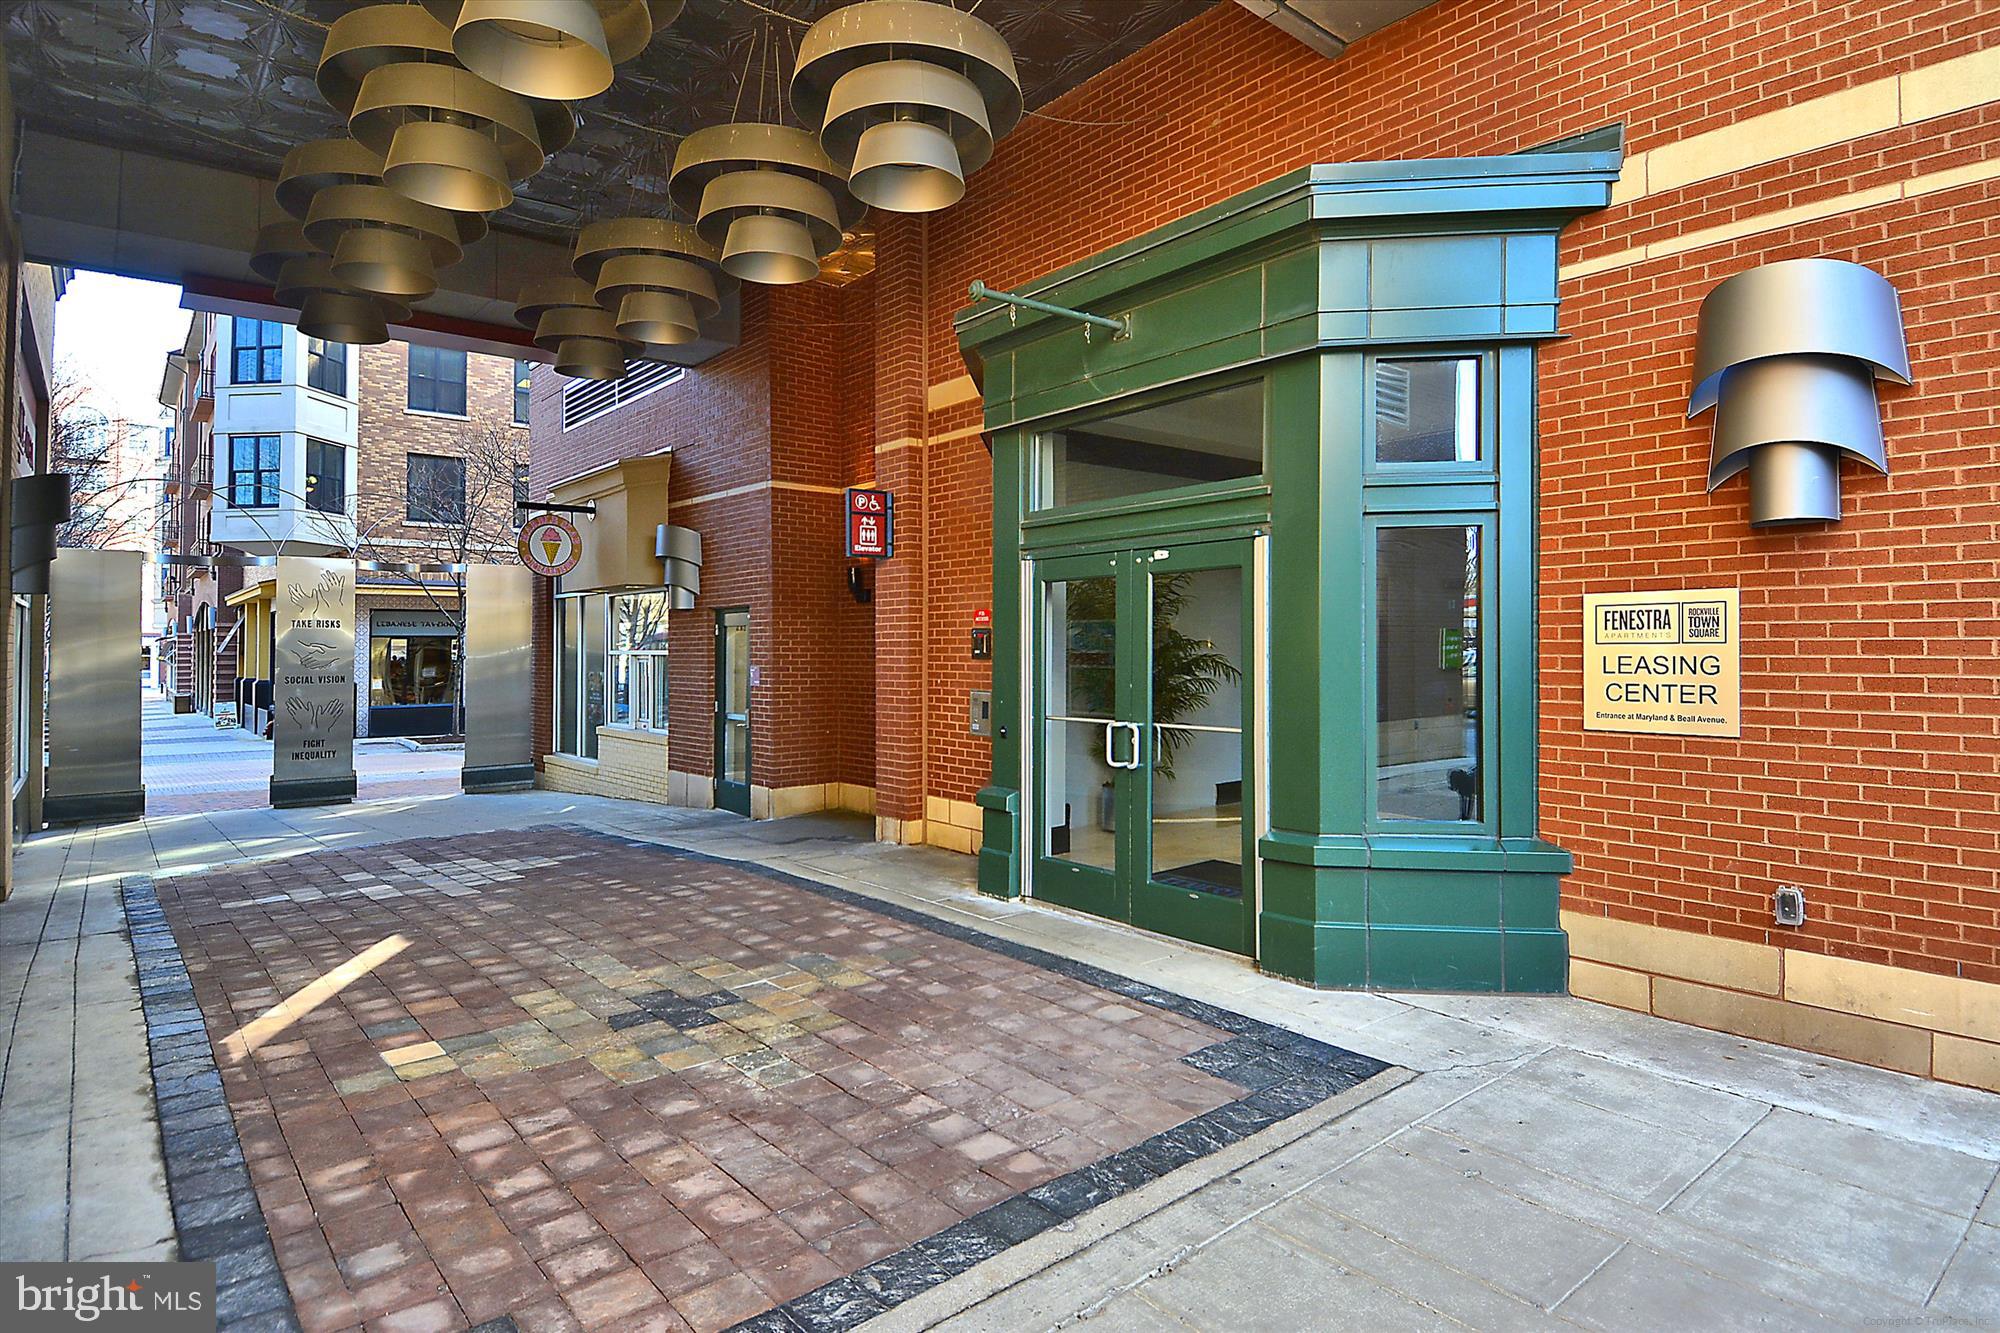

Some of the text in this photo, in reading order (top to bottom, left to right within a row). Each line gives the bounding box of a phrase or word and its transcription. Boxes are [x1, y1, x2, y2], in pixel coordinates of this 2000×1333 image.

[854, 545, 882, 553] Elevator
[1688, 607, 1720, 616] ROCKVILLE
[291, 620, 341, 628] TAKE RISKS
[1604, 609, 1671, 631] FENESTRA
[1688, 616, 1720, 628] TOWN
[1604, 631, 1672, 639] APARTMENTS
[1688, 628, 1720, 638] SQUARE
[1602, 655, 1720, 675] LEASING
[284, 675, 346, 684] SOCIAL VISION
[1605, 683, 1718, 704] CENTER
[1596, 712, 1626, 720] Entrance
[1636, 713, 1668, 723] Maryland
[1669, 714, 1675, 722] &
[1677, 714, 1696, 722] Beall
[1697, 715, 1728, 724] Avenue.
[303, 740, 326, 748] FIGHT
[292, 750, 336, 760] INEQUALITY
